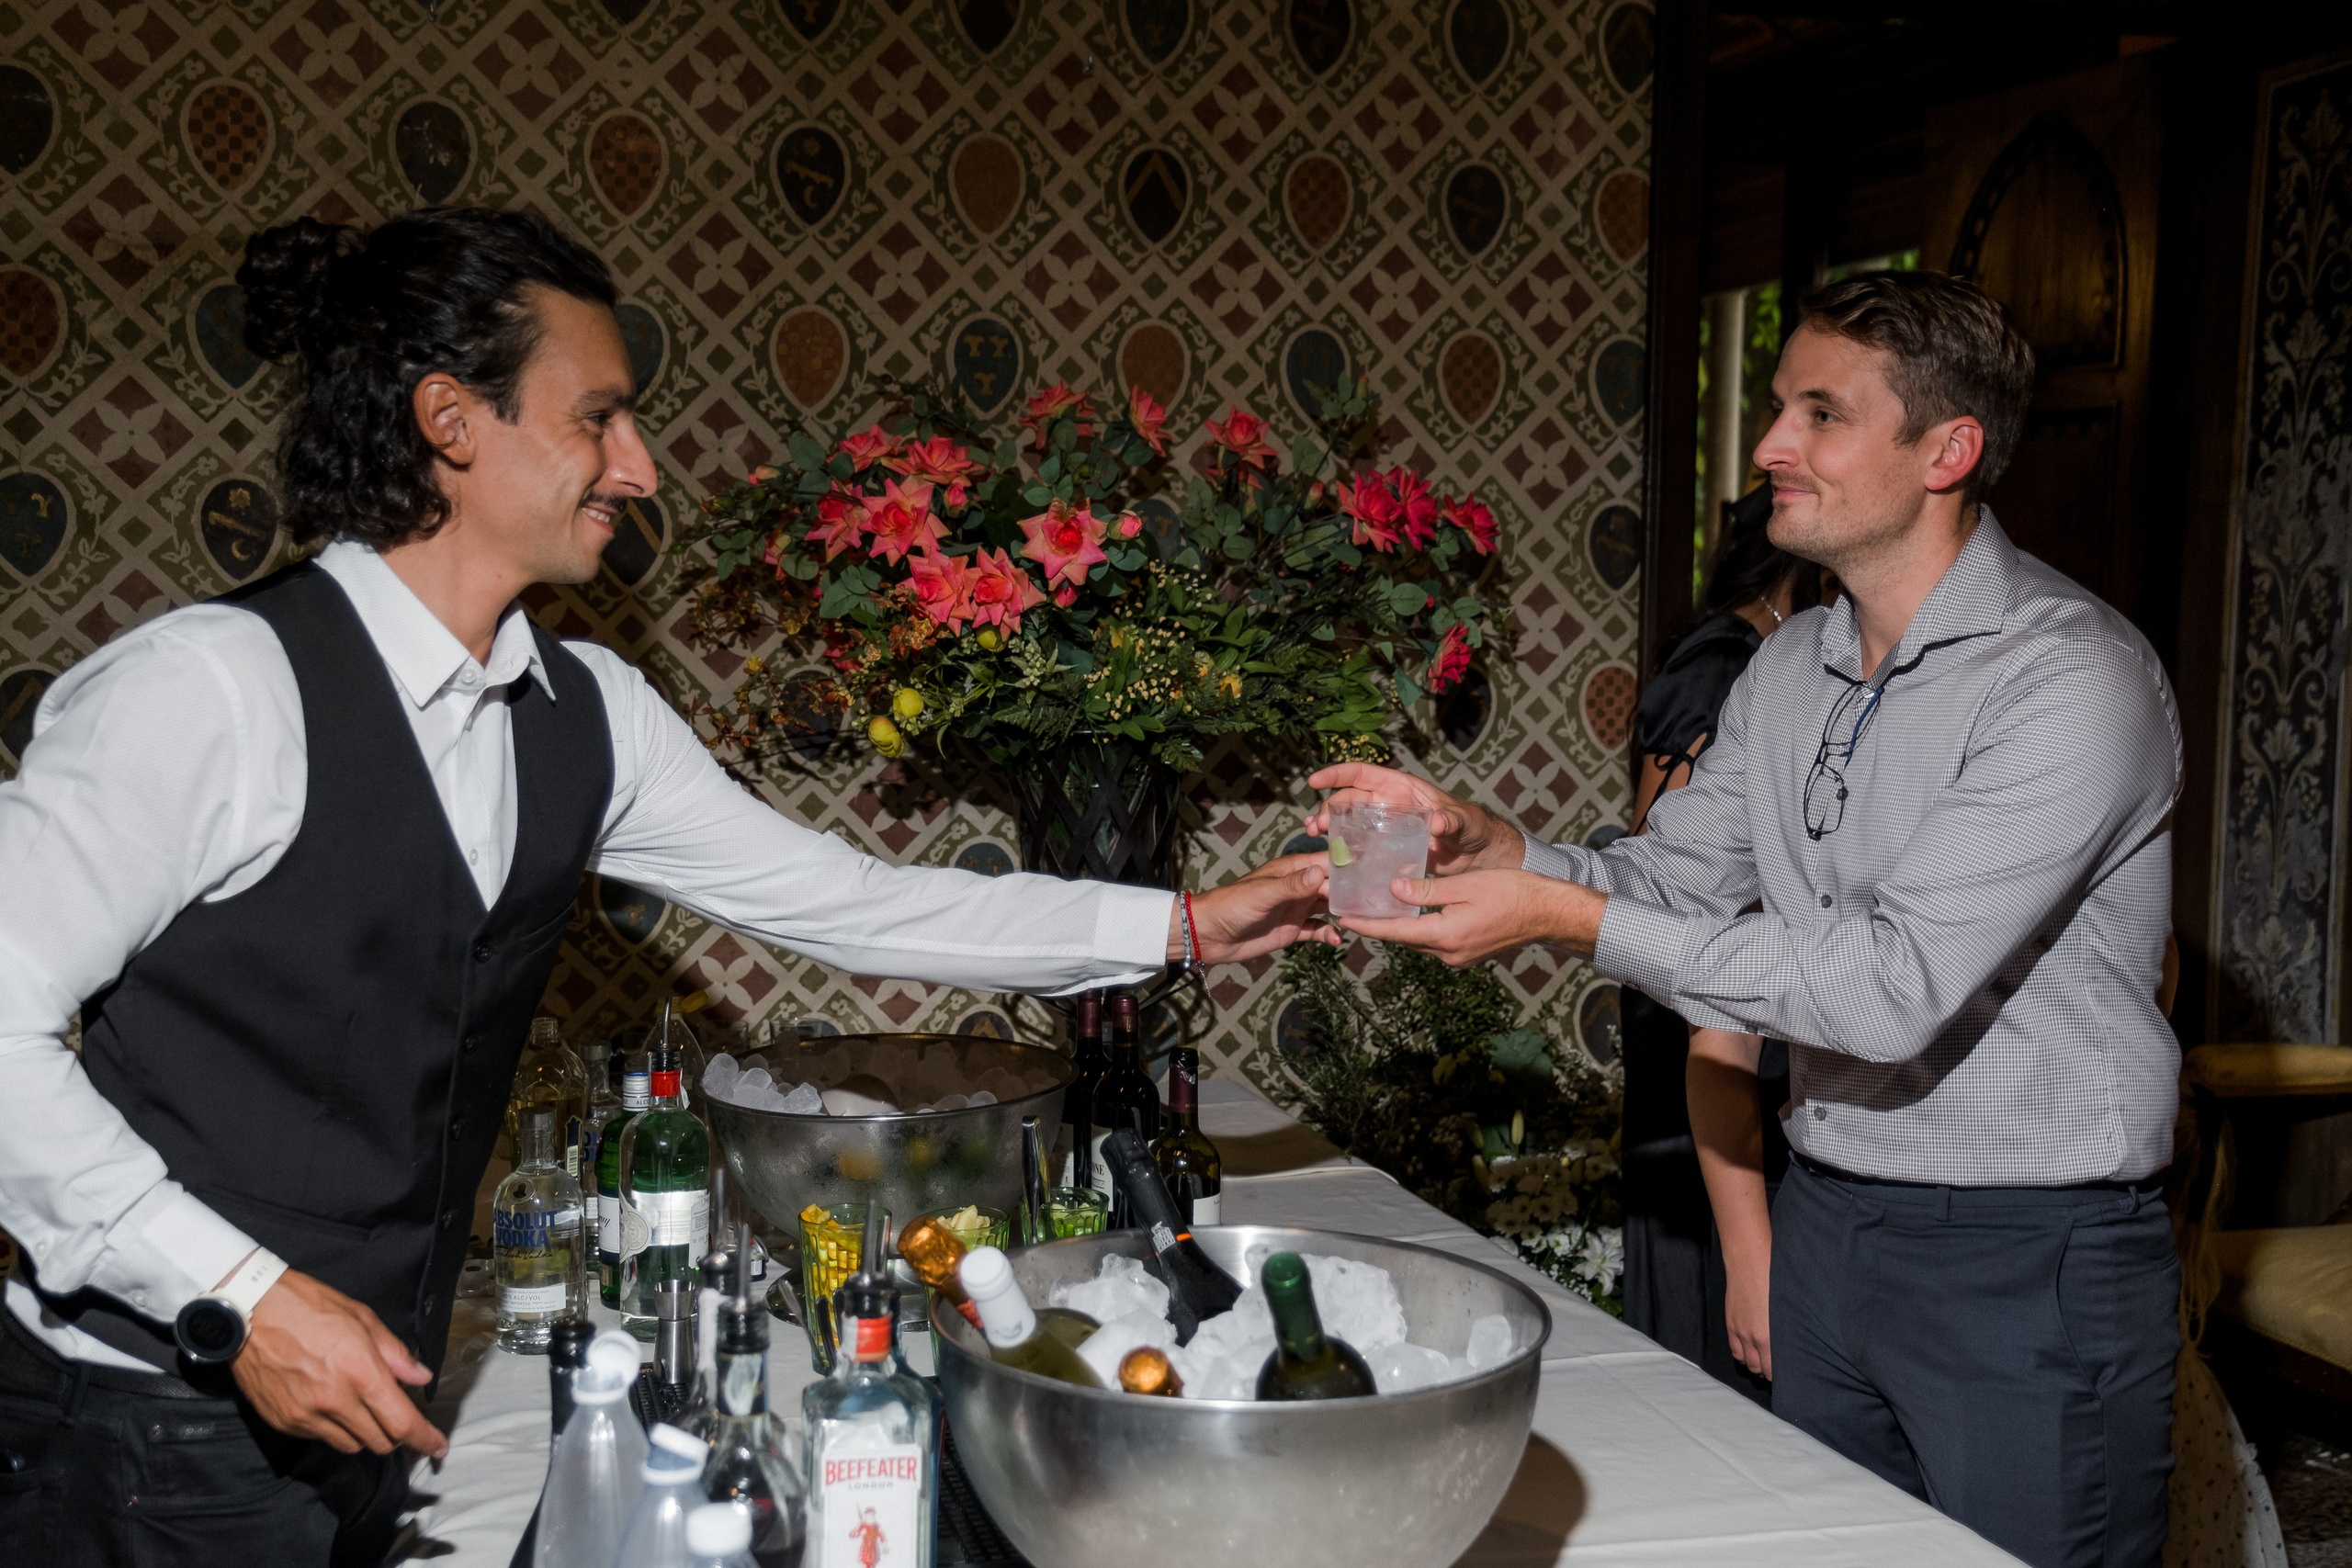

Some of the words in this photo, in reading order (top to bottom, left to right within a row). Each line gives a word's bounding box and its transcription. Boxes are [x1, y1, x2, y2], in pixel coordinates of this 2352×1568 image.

[496, 1228, 549, 1247] VODKA
[825, 1456, 917, 1486] BEEFEATER
[848, 1481, 893, 1490] LONDON
